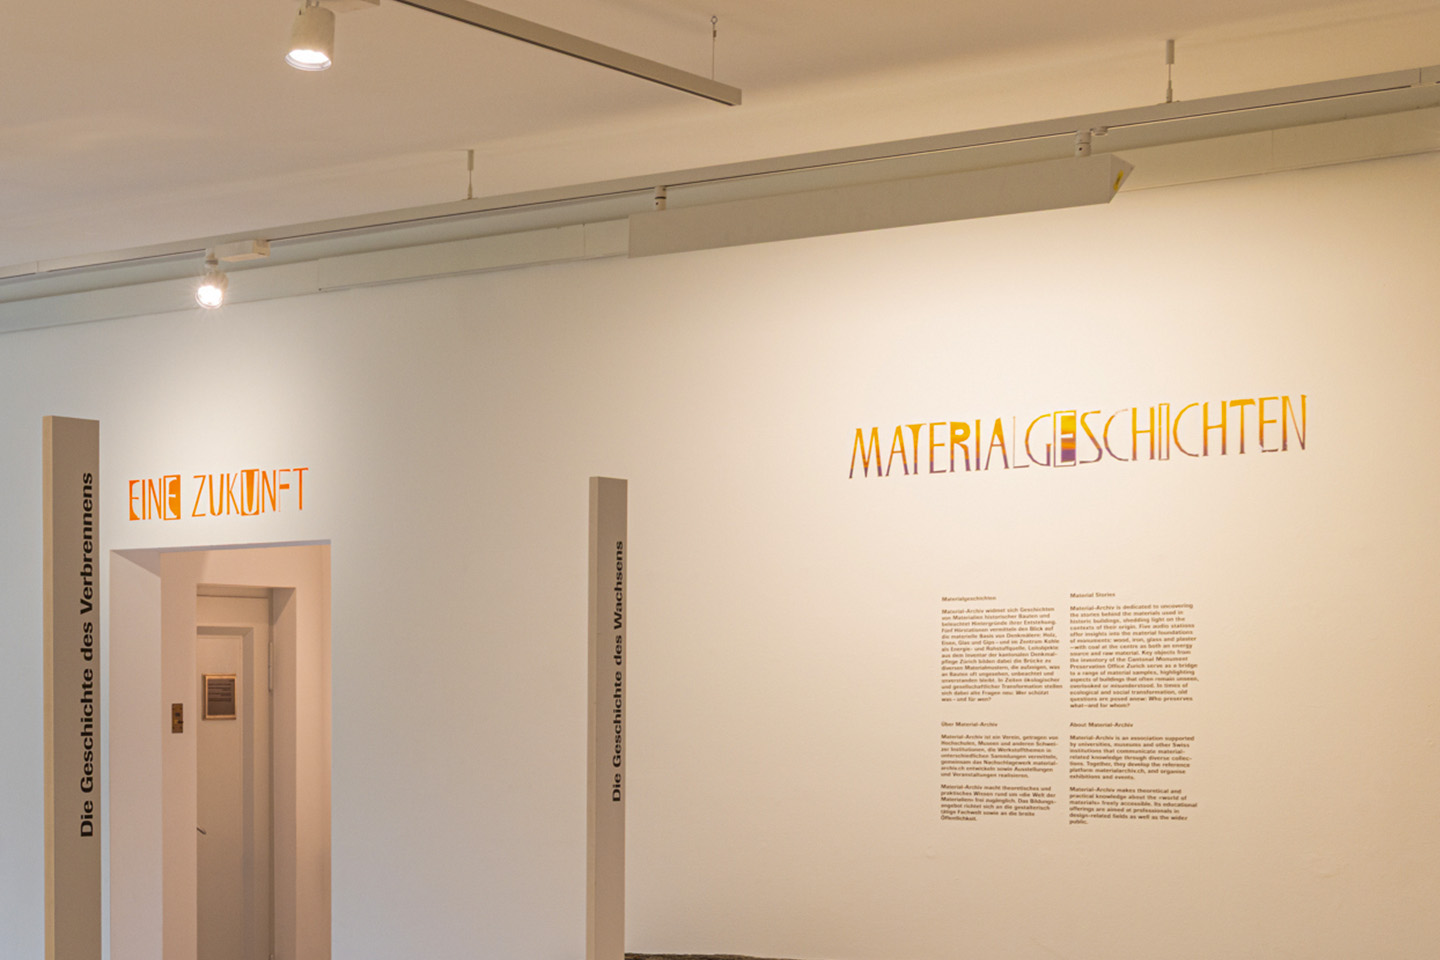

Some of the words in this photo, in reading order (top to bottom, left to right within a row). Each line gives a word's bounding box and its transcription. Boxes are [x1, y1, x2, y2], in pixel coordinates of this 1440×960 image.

[848, 394, 1308, 479] MATERIALGESCHICHTEN
[128, 474, 182, 521] EINE
[191, 467, 309, 517] ZUKUNFT
[79, 472, 94, 615] Verbrennens
[613, 540, 623, 630] Wachsens
[79, 621, 94, 662] des
[613, 634, 623, 666] des
[79, 668, 94, 794] Geschichte
[613, 671, 622, 768] Geschichte
[80, 800, 94, 838] Die
[613, 773, 622, 802] Die
